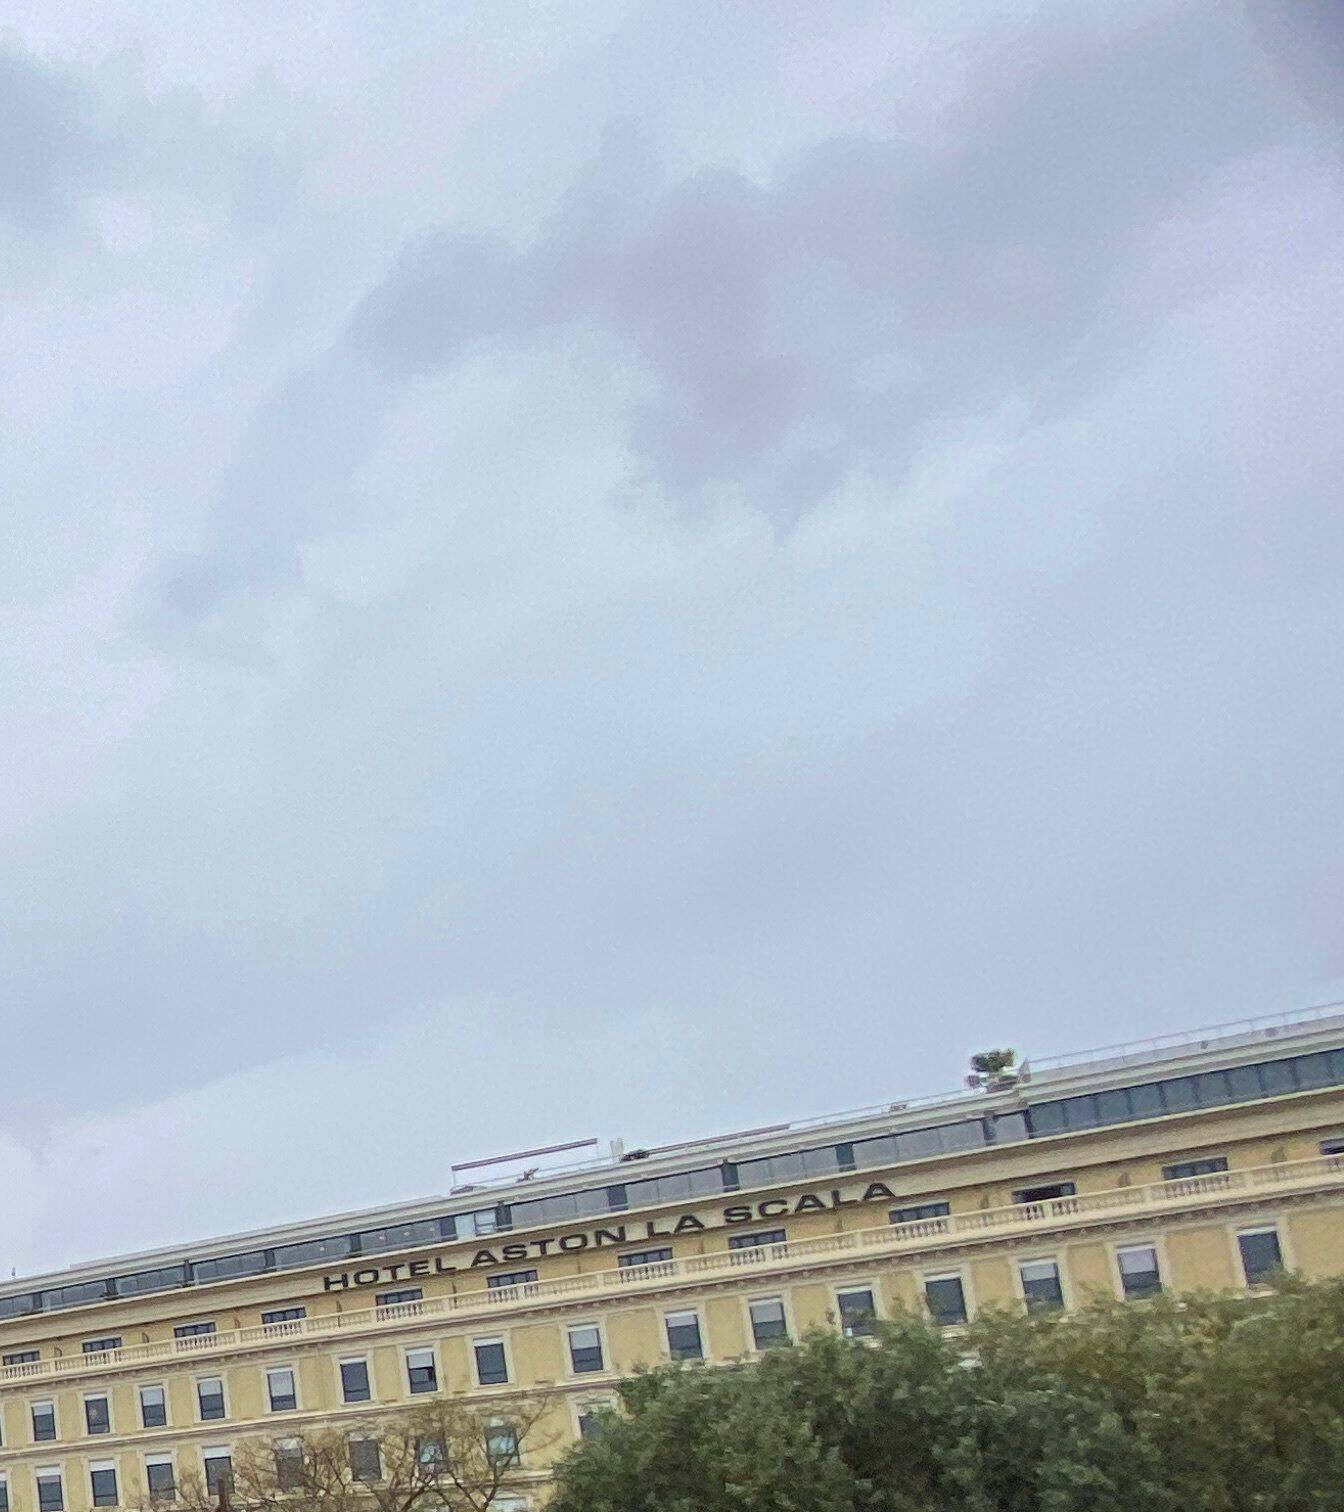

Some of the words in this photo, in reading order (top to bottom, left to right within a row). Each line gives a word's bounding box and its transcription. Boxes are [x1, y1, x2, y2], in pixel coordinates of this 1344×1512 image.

[322, 1256, 457, 1291] HOTEL
[469, 1225, 626, 1268] ASTON
[646, 1213, 706, 1240] LA
[722, 1181, 897, 1224] SCALA
